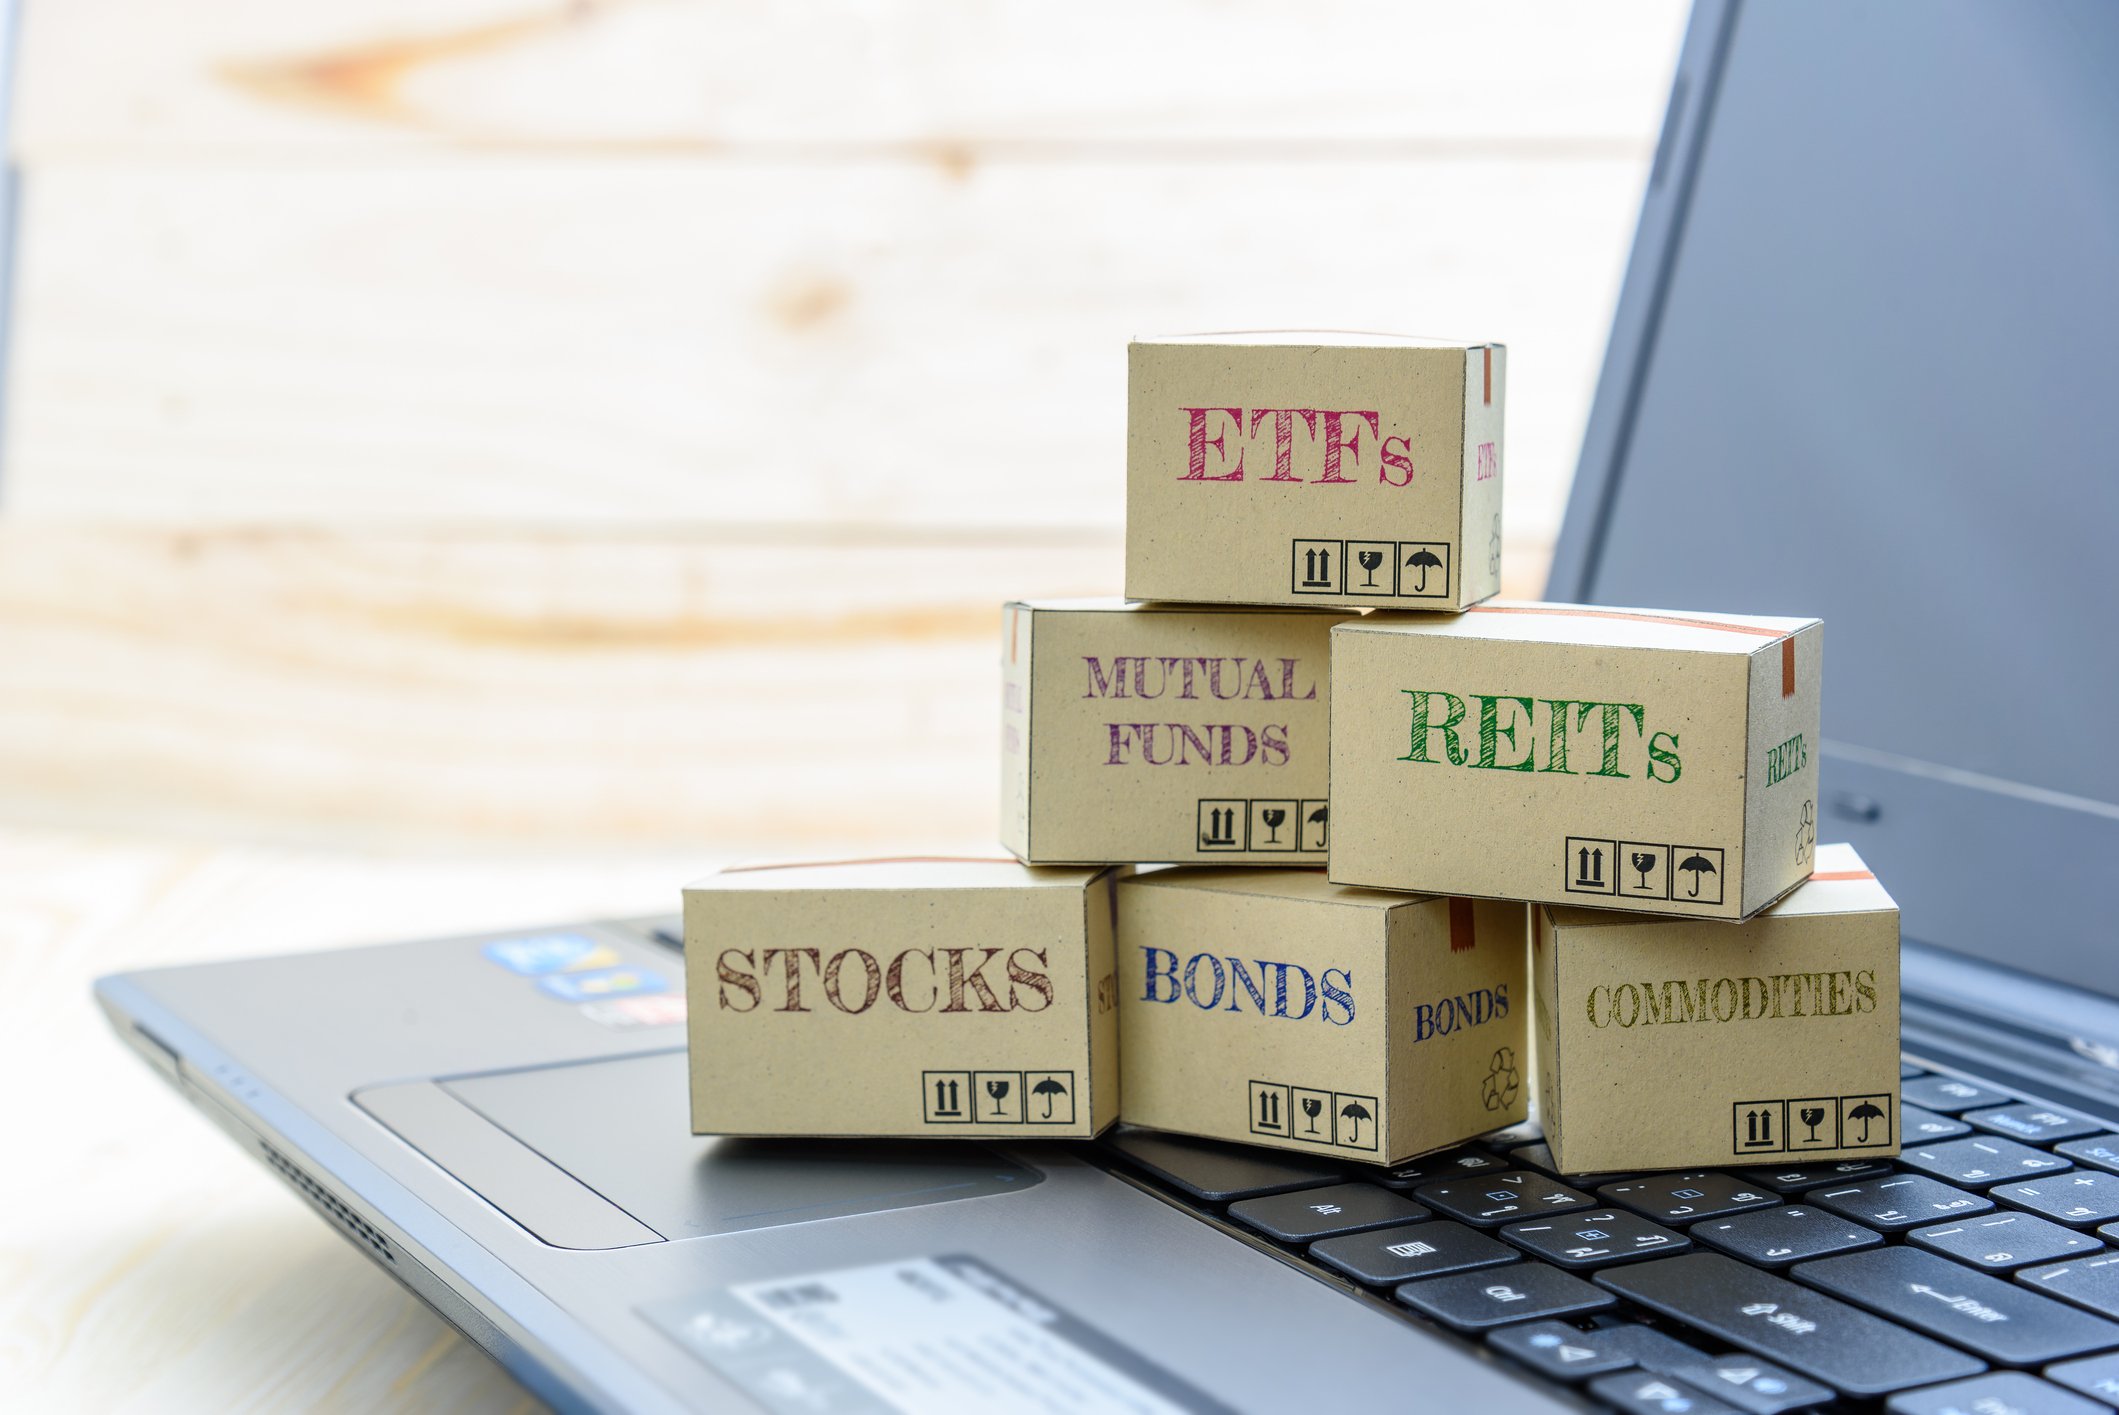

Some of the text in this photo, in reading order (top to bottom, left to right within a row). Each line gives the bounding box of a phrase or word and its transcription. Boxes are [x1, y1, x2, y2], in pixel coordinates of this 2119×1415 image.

[1177, 407, 1414, 487] ETFs
[1081, 656, 1317, 701] MUTUAL
[1103, 722, 1292, 767] FUNDS
[1397, 689, 1682, 784] REITs
[1765, 732, 1807, 788] REITs
[716, 946, 1054, 1015] STOCKS
[1138, 945, 1356, 1026] BONDS
[1586, 968, 1878, 1029] COMMODITIES
[1413, 983, 1510, 1043] BONDS
[1309, 1204, 1341, 1216] Alt
[1485, 1285, 1526, 1302] Ctrl
[1952, 1299, 2008, 1322] Enter
[1767, 1312, 1817, 1334] Shift
